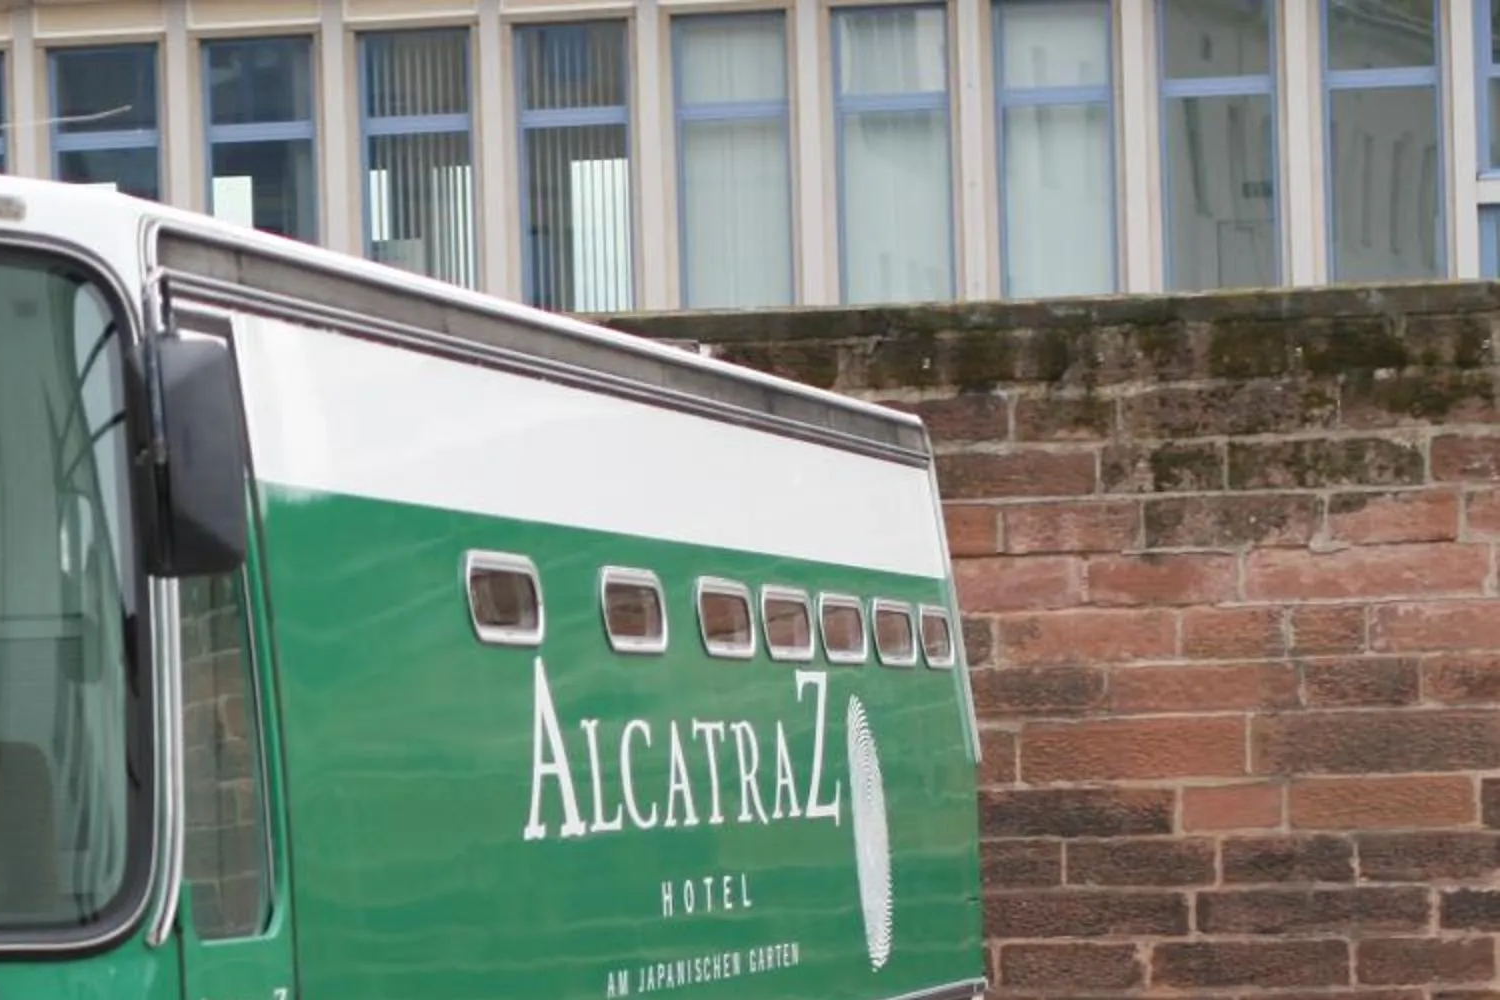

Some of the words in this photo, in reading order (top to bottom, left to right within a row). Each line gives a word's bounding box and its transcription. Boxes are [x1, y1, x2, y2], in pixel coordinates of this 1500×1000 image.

[523, 656, 841, 841] ALCATRAZ
[662, 873, 752, 918] HOTEL
[606, 970, 630, 999] AM
[638, 951, 741, 994] JAPANISCHEN
[749, 941, 800, 975] GARTEN
